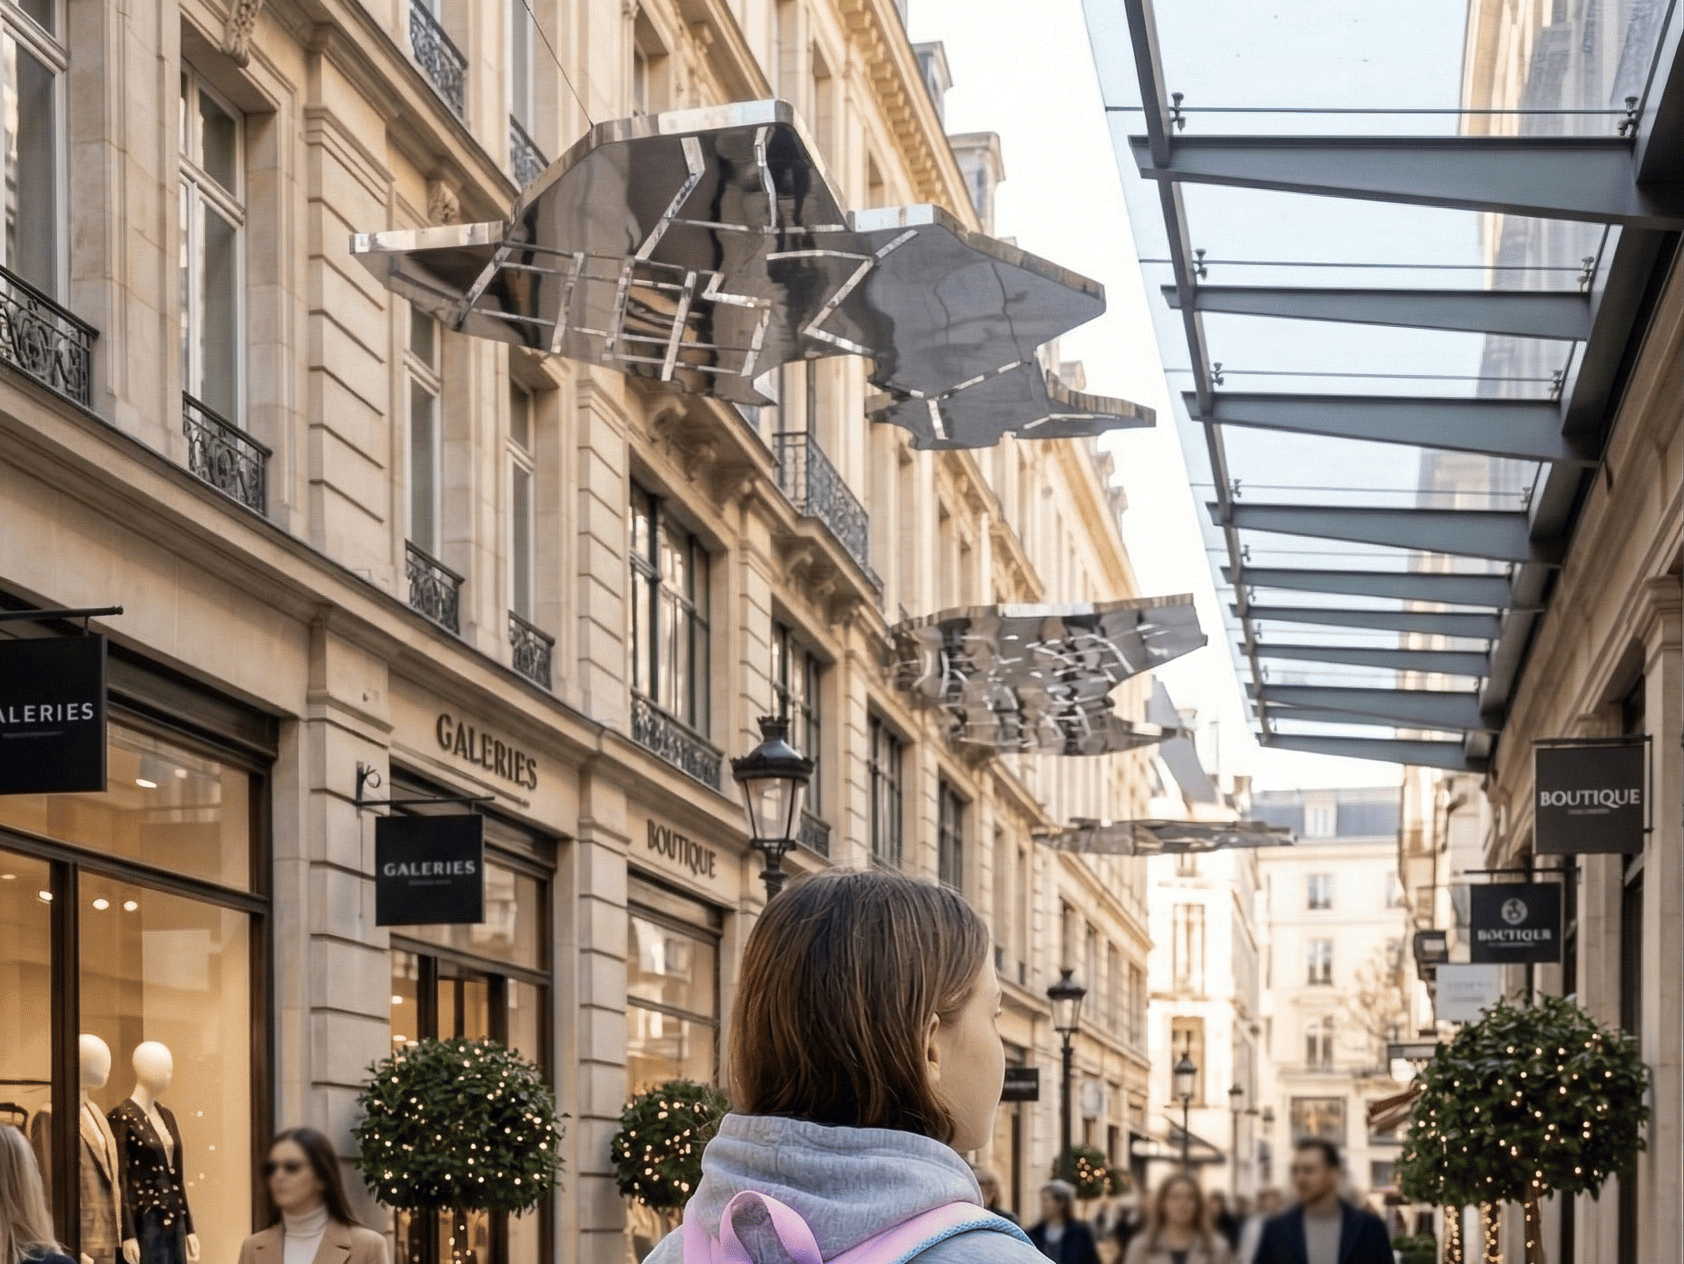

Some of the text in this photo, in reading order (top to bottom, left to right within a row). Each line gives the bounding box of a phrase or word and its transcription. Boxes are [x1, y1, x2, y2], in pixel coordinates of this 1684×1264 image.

[436, 713, 537, 791] GALERIES
[1540, 788, 1641, 809] BOUTIQUE
[383, 860, 476, 877] GALERIES
[647, 818, 717, 879] BOUTIQUE
